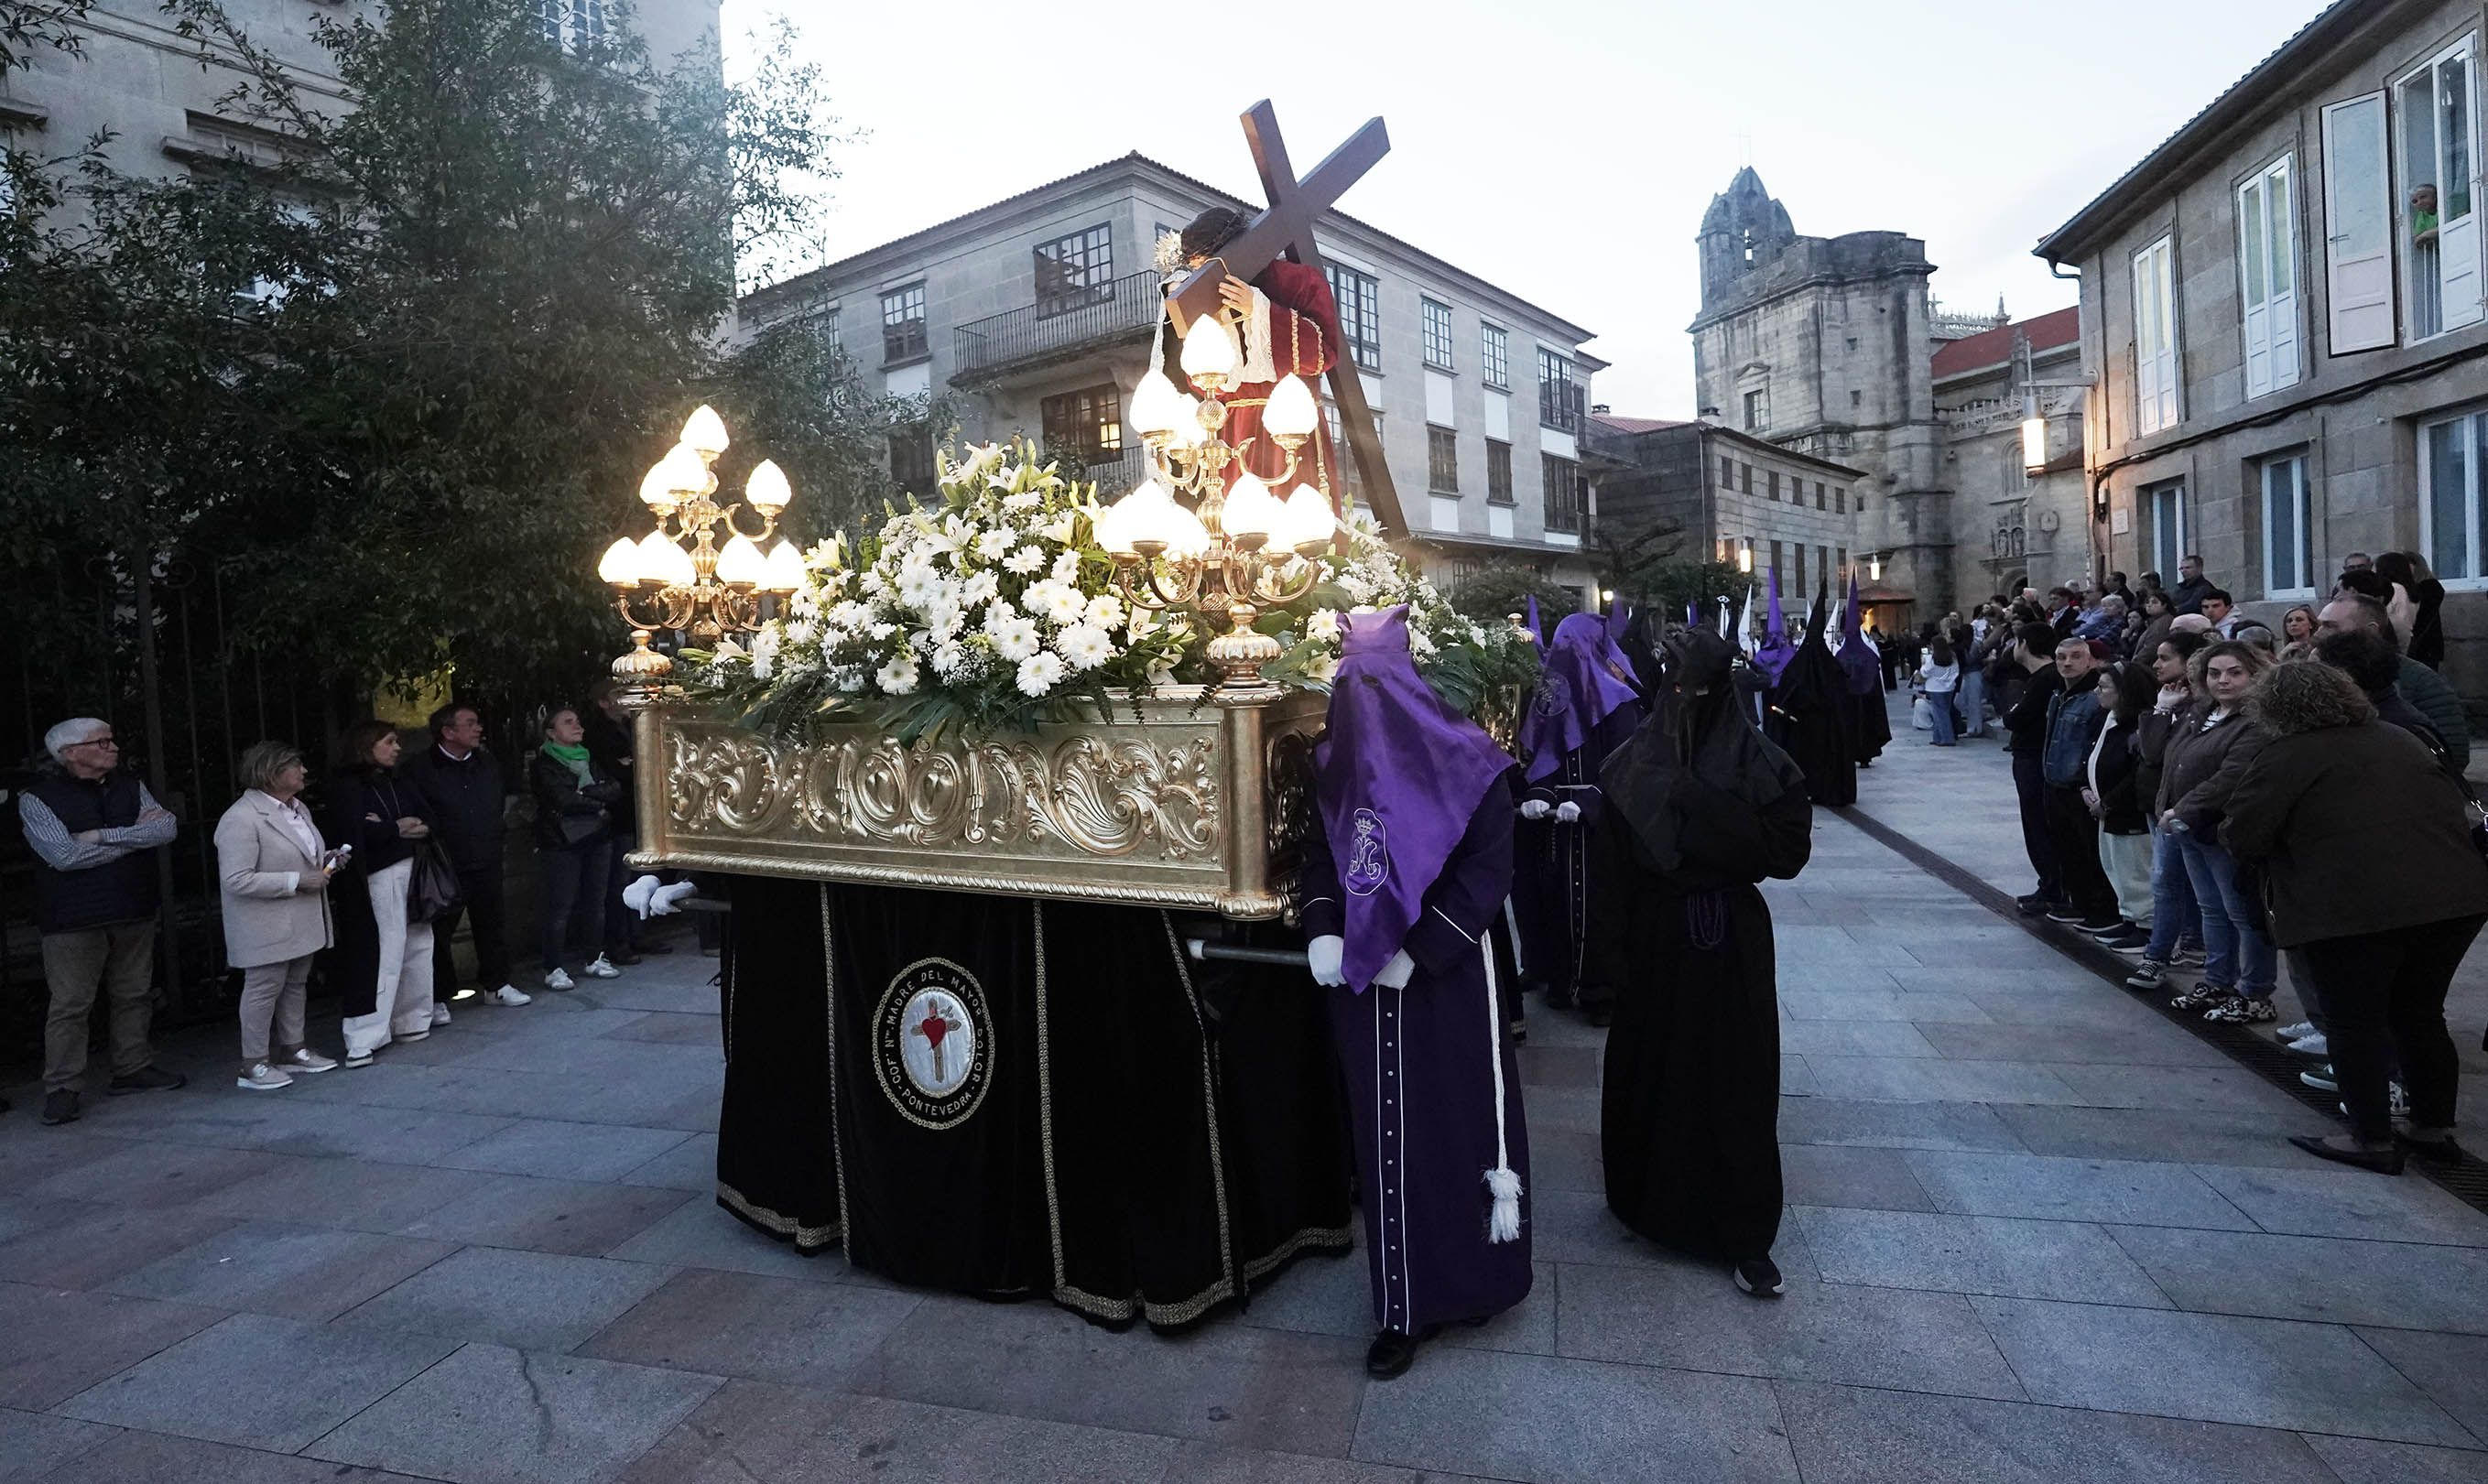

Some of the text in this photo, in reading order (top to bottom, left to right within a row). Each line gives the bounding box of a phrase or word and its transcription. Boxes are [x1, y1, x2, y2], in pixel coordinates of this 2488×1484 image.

[886, 981, 916, 1025] MADRE
[921, 970, 943, 980] DEL
[951, 976, 982, 1017] MAYOR
[972, 1029, 983, 1083] DOLOR
[902, 1089, 972, 1116] PONTEVEDRA
